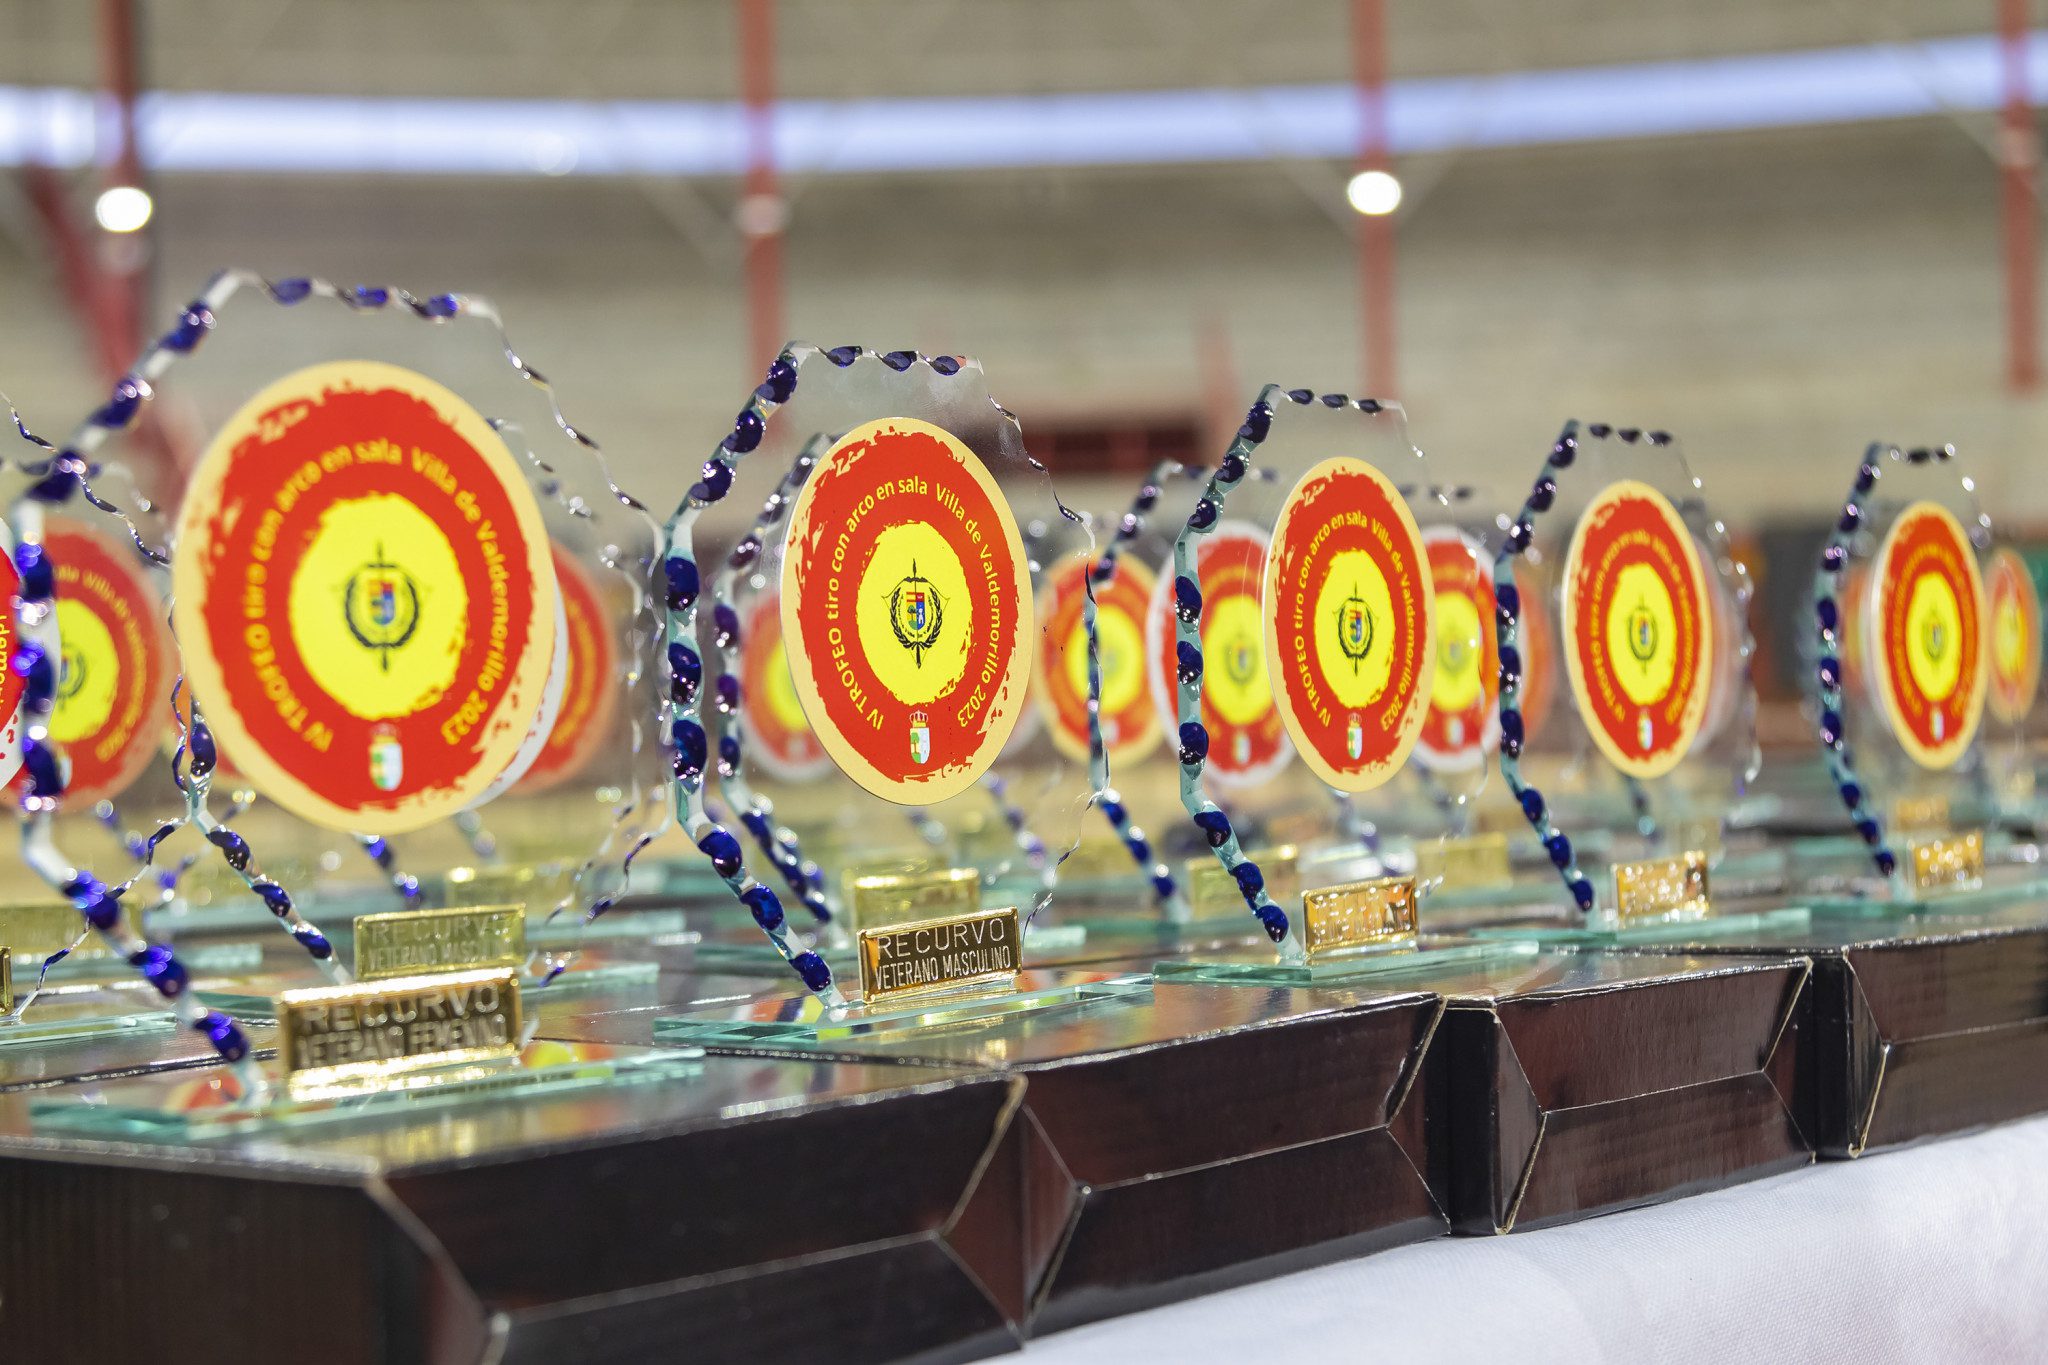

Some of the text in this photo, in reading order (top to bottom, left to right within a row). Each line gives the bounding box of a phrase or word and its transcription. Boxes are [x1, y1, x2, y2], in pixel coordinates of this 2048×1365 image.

[355, 438, 402, 464] sala
[412, 446, 460, 494] Villa
[477, 520, 508, 691] Valdemorillo
[824, 475, 1001, 731] IV TROFEO tiro con arco en sala Villa de Valdemorillo 2023
[1293, 510, 1416, 732] IV TROFEO tiro con arco en sala Villa de Valdemorillo 2023
[442, 690, 487, 744] 2023
[877, 918, 1005, 960] RECURVO
[875, 945, 1011, 990] VETERANO MASCULINO
[302, 983, 500, 1032] RECURVO
